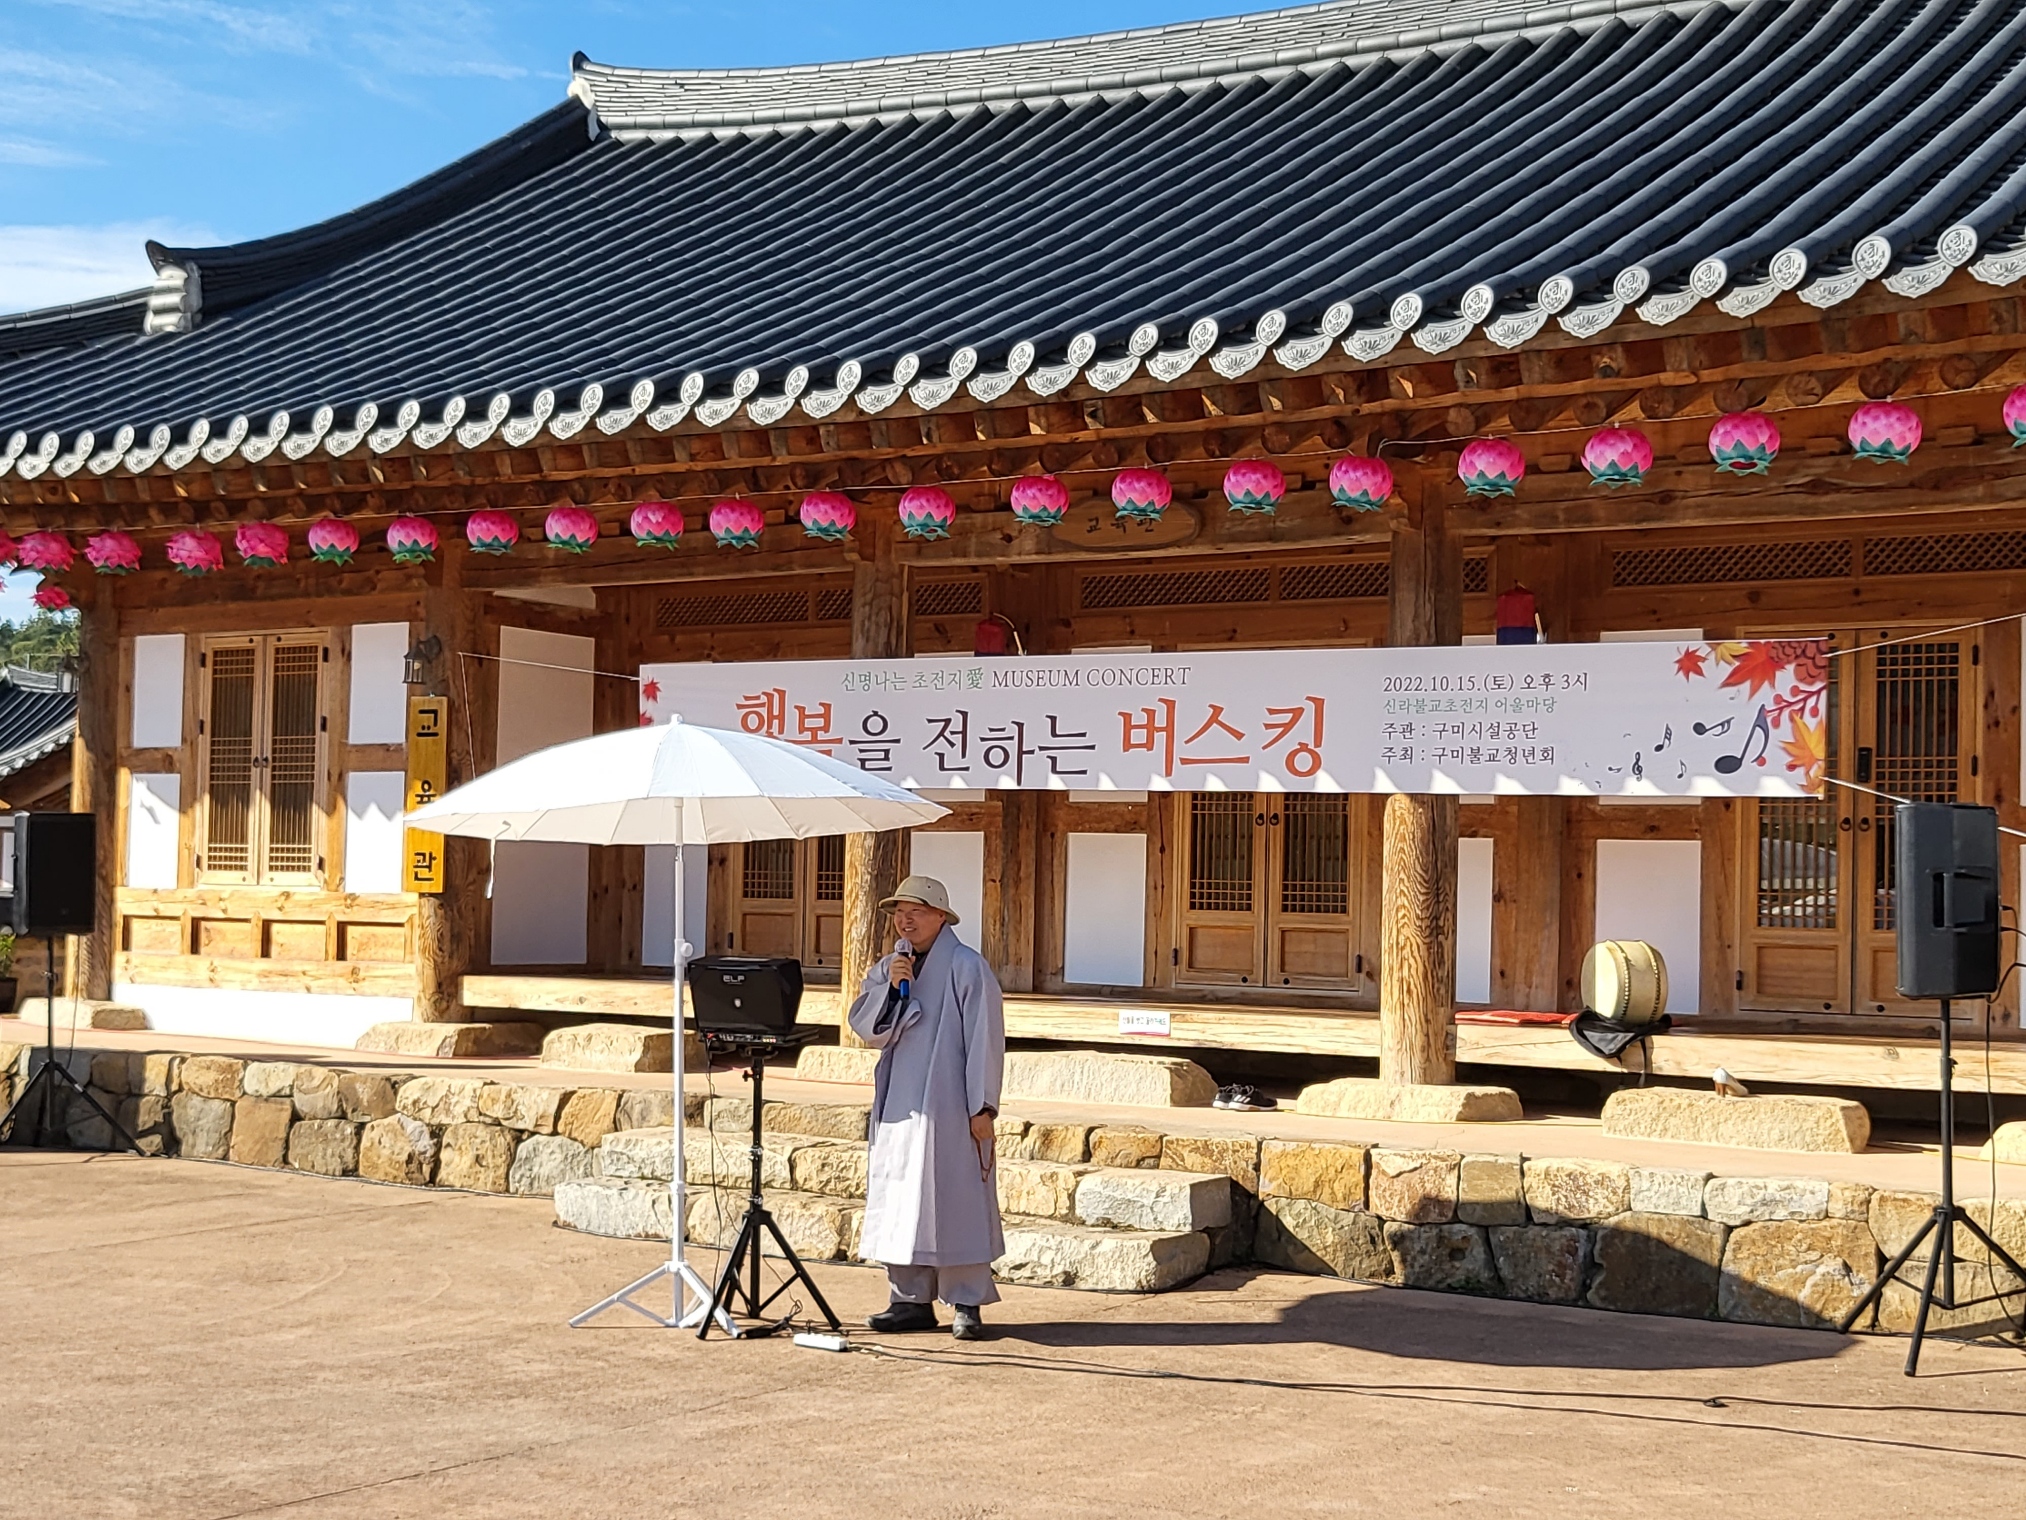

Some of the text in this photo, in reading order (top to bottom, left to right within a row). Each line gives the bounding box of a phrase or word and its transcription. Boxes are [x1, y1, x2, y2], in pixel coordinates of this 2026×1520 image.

[841, 666, 1192, 692] 신명나는 초전지愛 MUSEUM CONCERT
[1383, 672, 1588, 693] 2022.10.15.(토) 오후 3시
[1383, 696, 1558, 715] 신라불교초전지 어울마당
[735, 687, 1326, 787] 행복을 전하는 버스킹
[1381, 722, 1416, 741] 주관
[1432, 721, 1539, 741] 구미시설공단
[1380, 746, 1415, 765] 주최
[1431, 745, 1556, 765] 구미불교청년회
